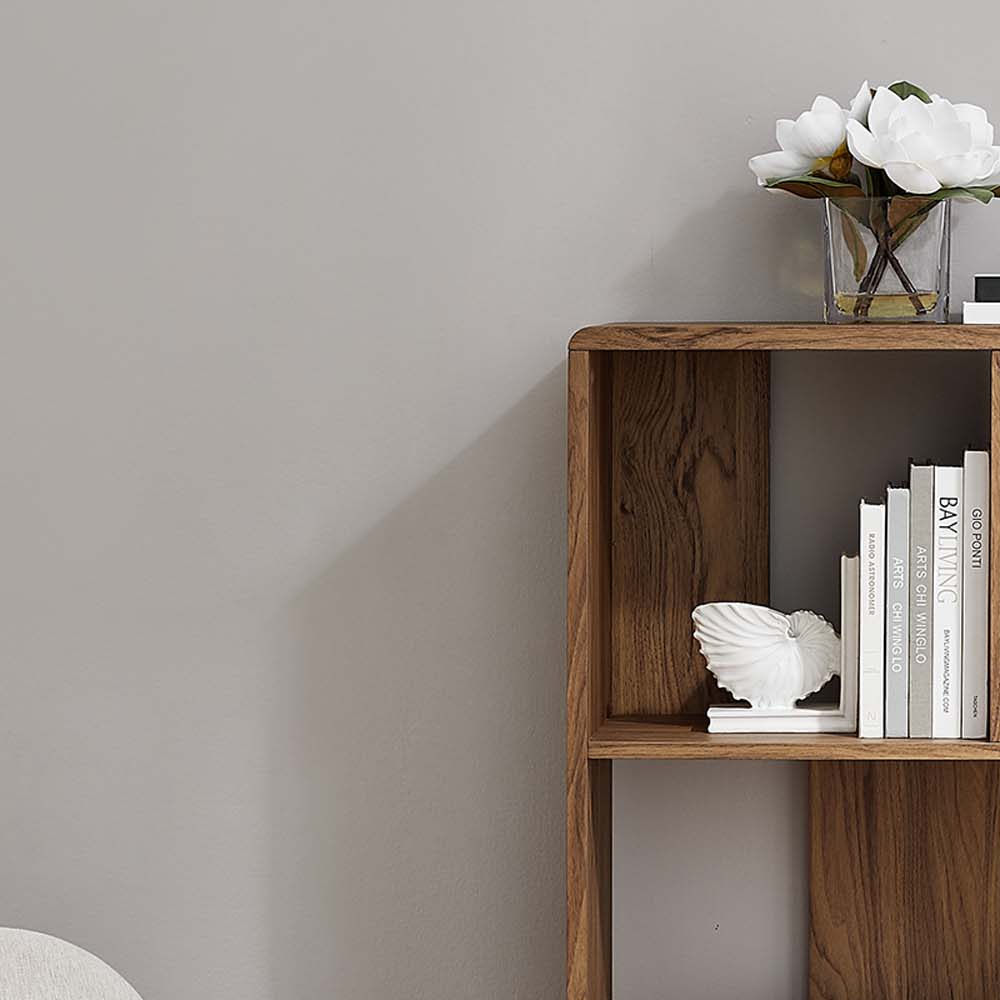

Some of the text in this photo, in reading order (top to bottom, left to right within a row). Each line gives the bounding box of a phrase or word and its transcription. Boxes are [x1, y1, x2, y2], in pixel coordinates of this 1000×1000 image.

[868, 532, 877, 616] RADIO ASTRONOMER
[892, 556, 905, 590] ARTS
[971, 507, 983, 569] GIO PONTI
[914, 545, 929, 664] ARTS CHI WINGLO
